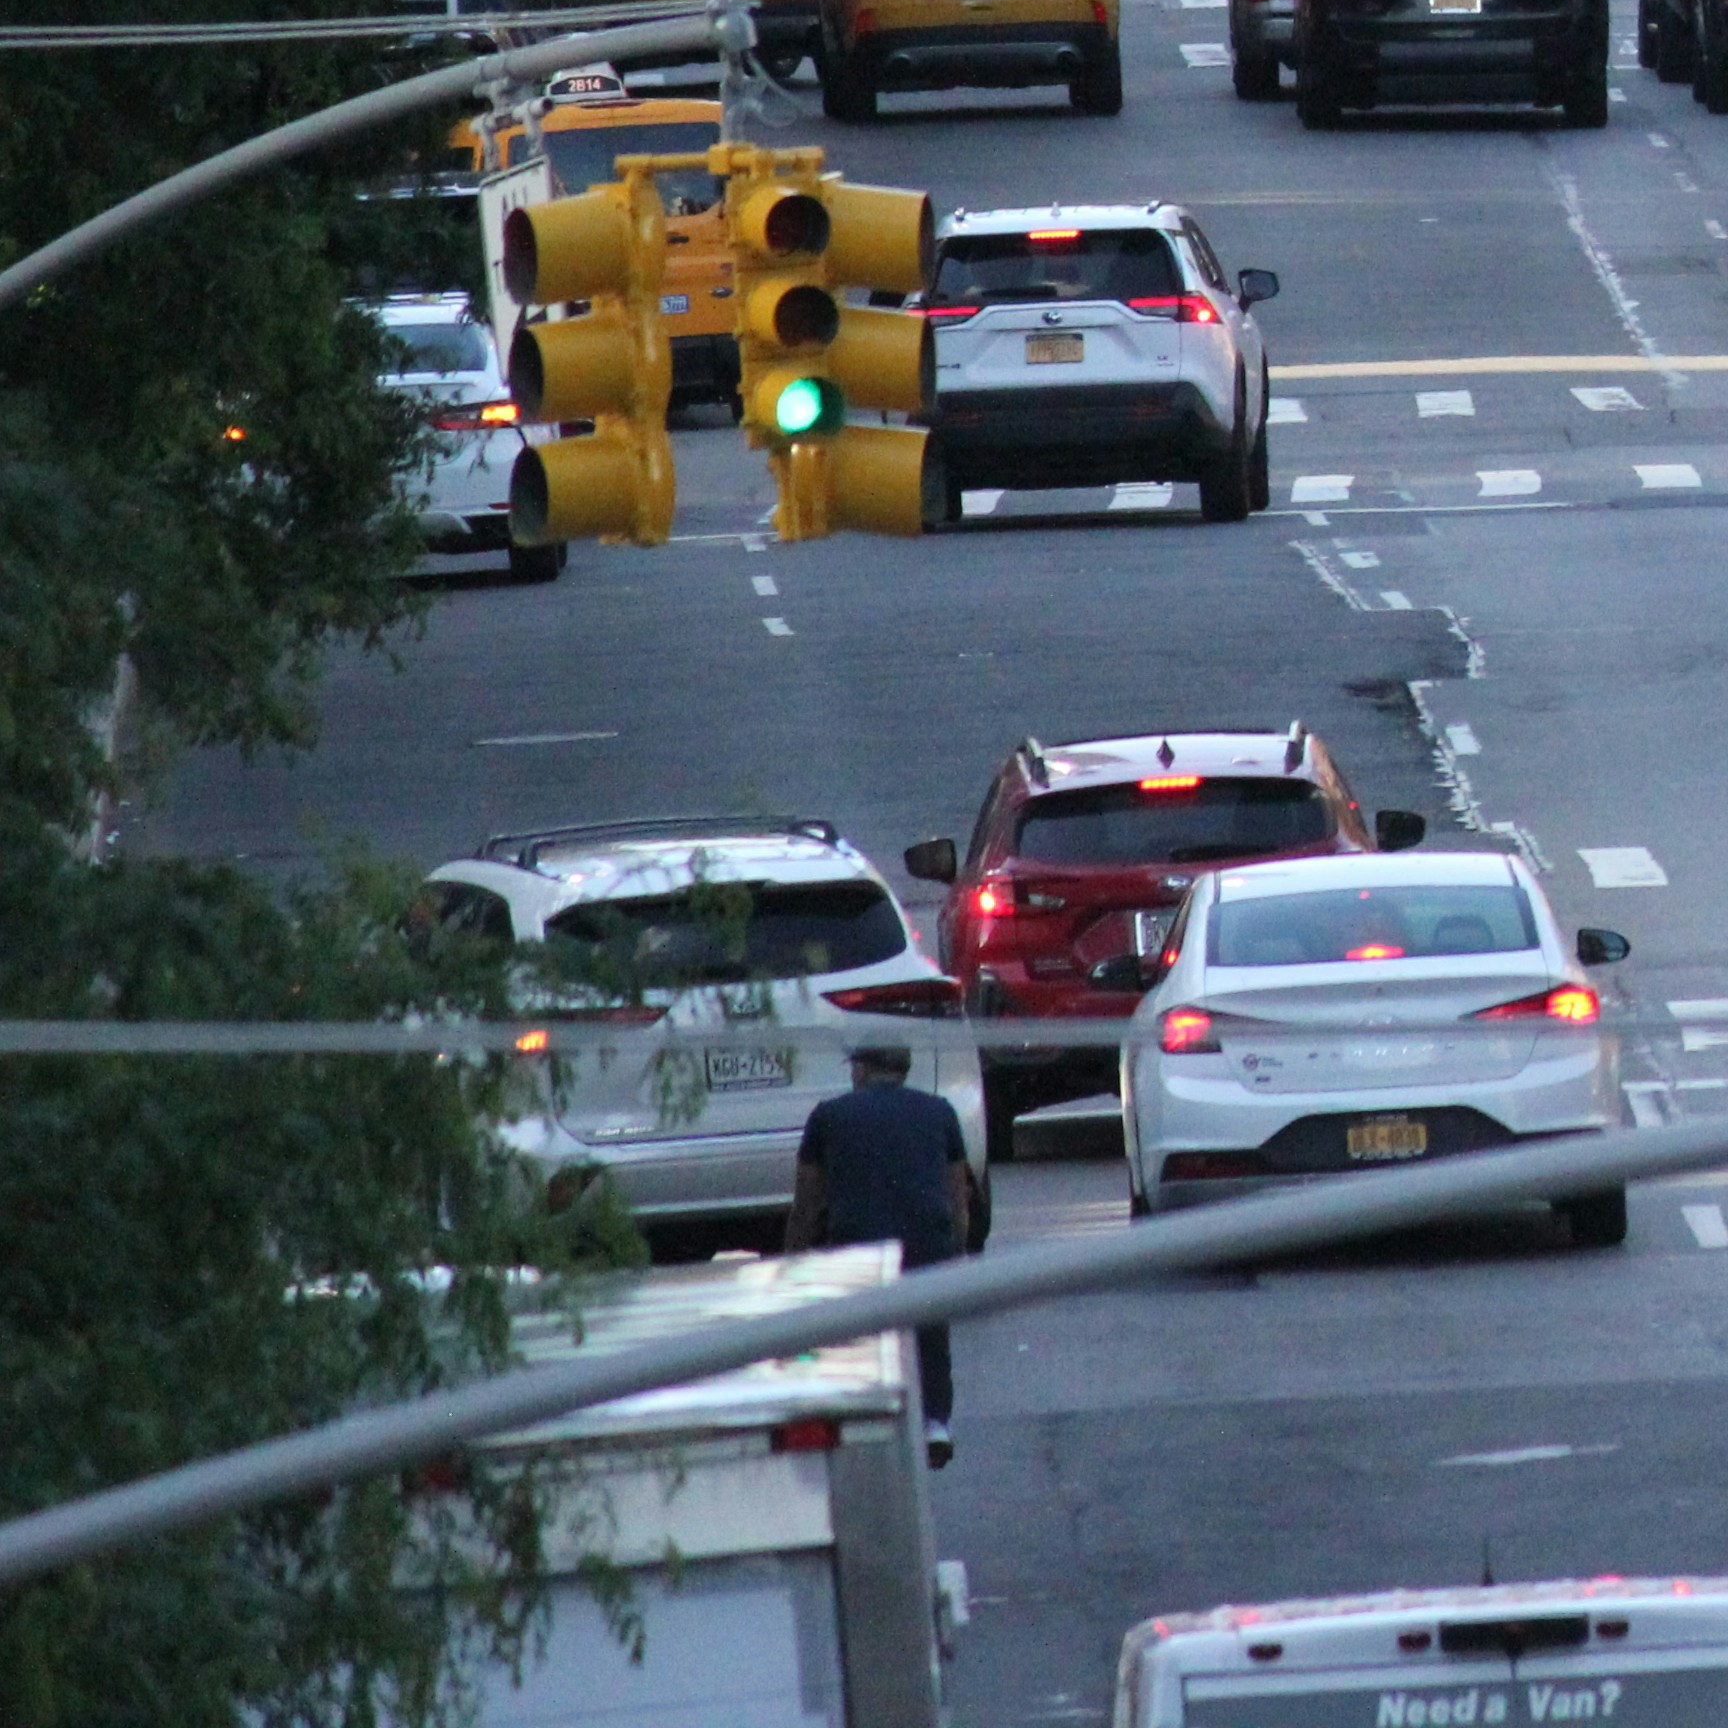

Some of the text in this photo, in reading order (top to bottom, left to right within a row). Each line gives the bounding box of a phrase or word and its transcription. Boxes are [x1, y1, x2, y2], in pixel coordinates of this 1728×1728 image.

[567, 77, 601, 92] 2B14
[1377, 1688, 1478, 1728] Need
[1529, 1679, 1621, 1721] Van?
